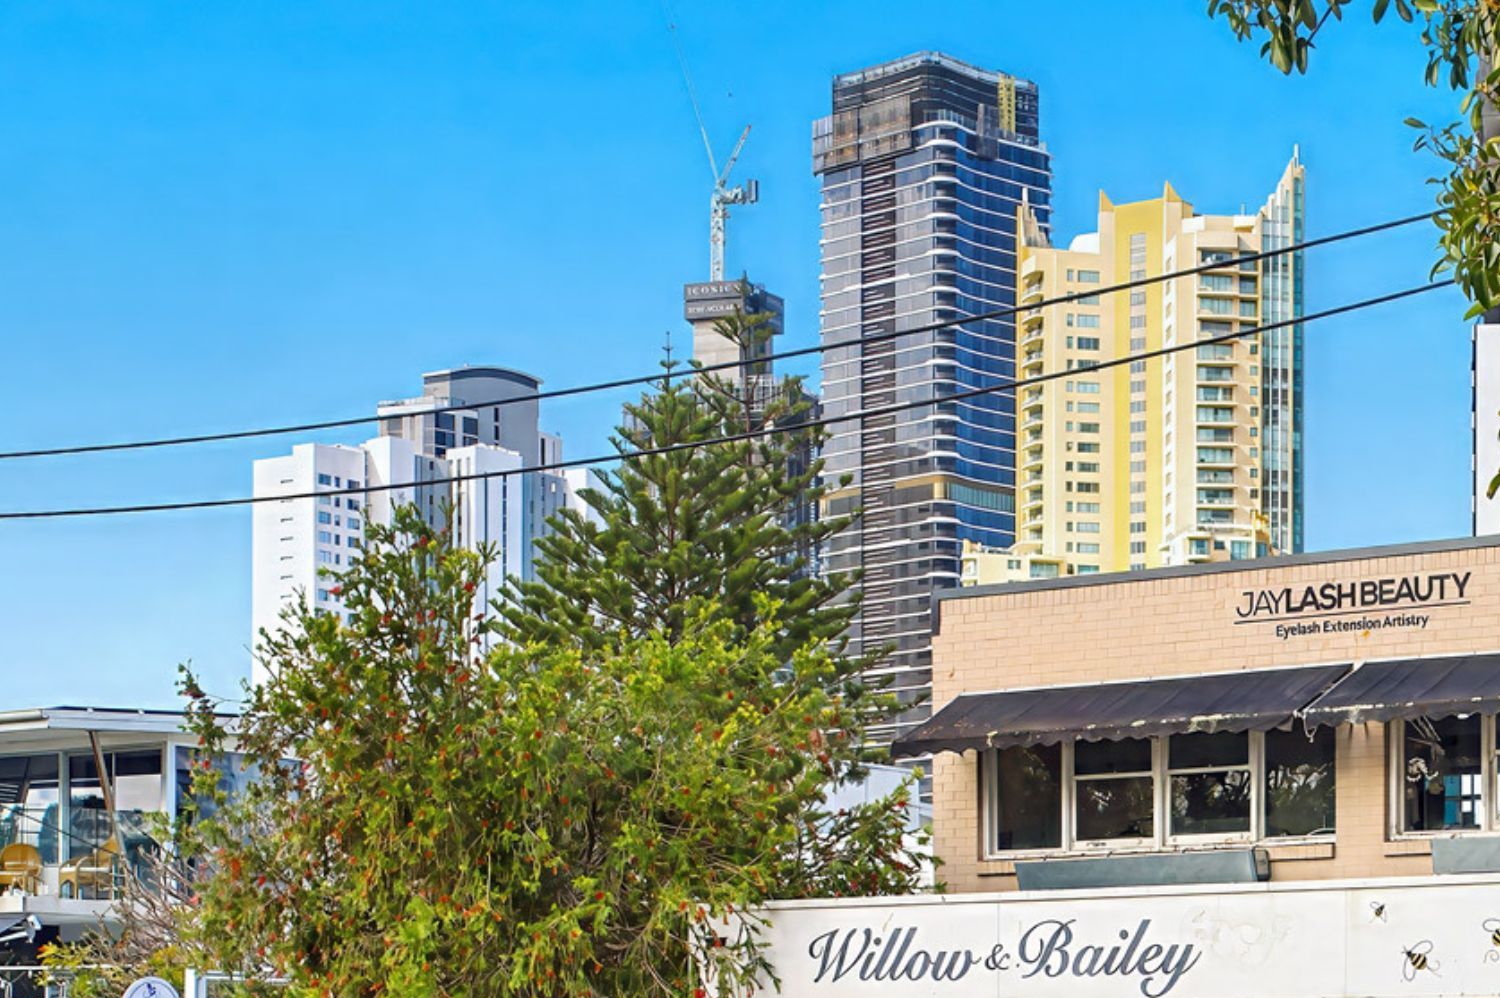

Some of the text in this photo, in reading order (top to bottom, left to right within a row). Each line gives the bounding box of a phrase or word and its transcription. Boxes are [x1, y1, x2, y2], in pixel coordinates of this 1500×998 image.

[1236, 572, 1471, 618] JAYLASH BEAUTY
[1276, 614, 1429, 640] Eyelash Extension Artistry
[808, 919, 1202, 998] Willow & Bailey
